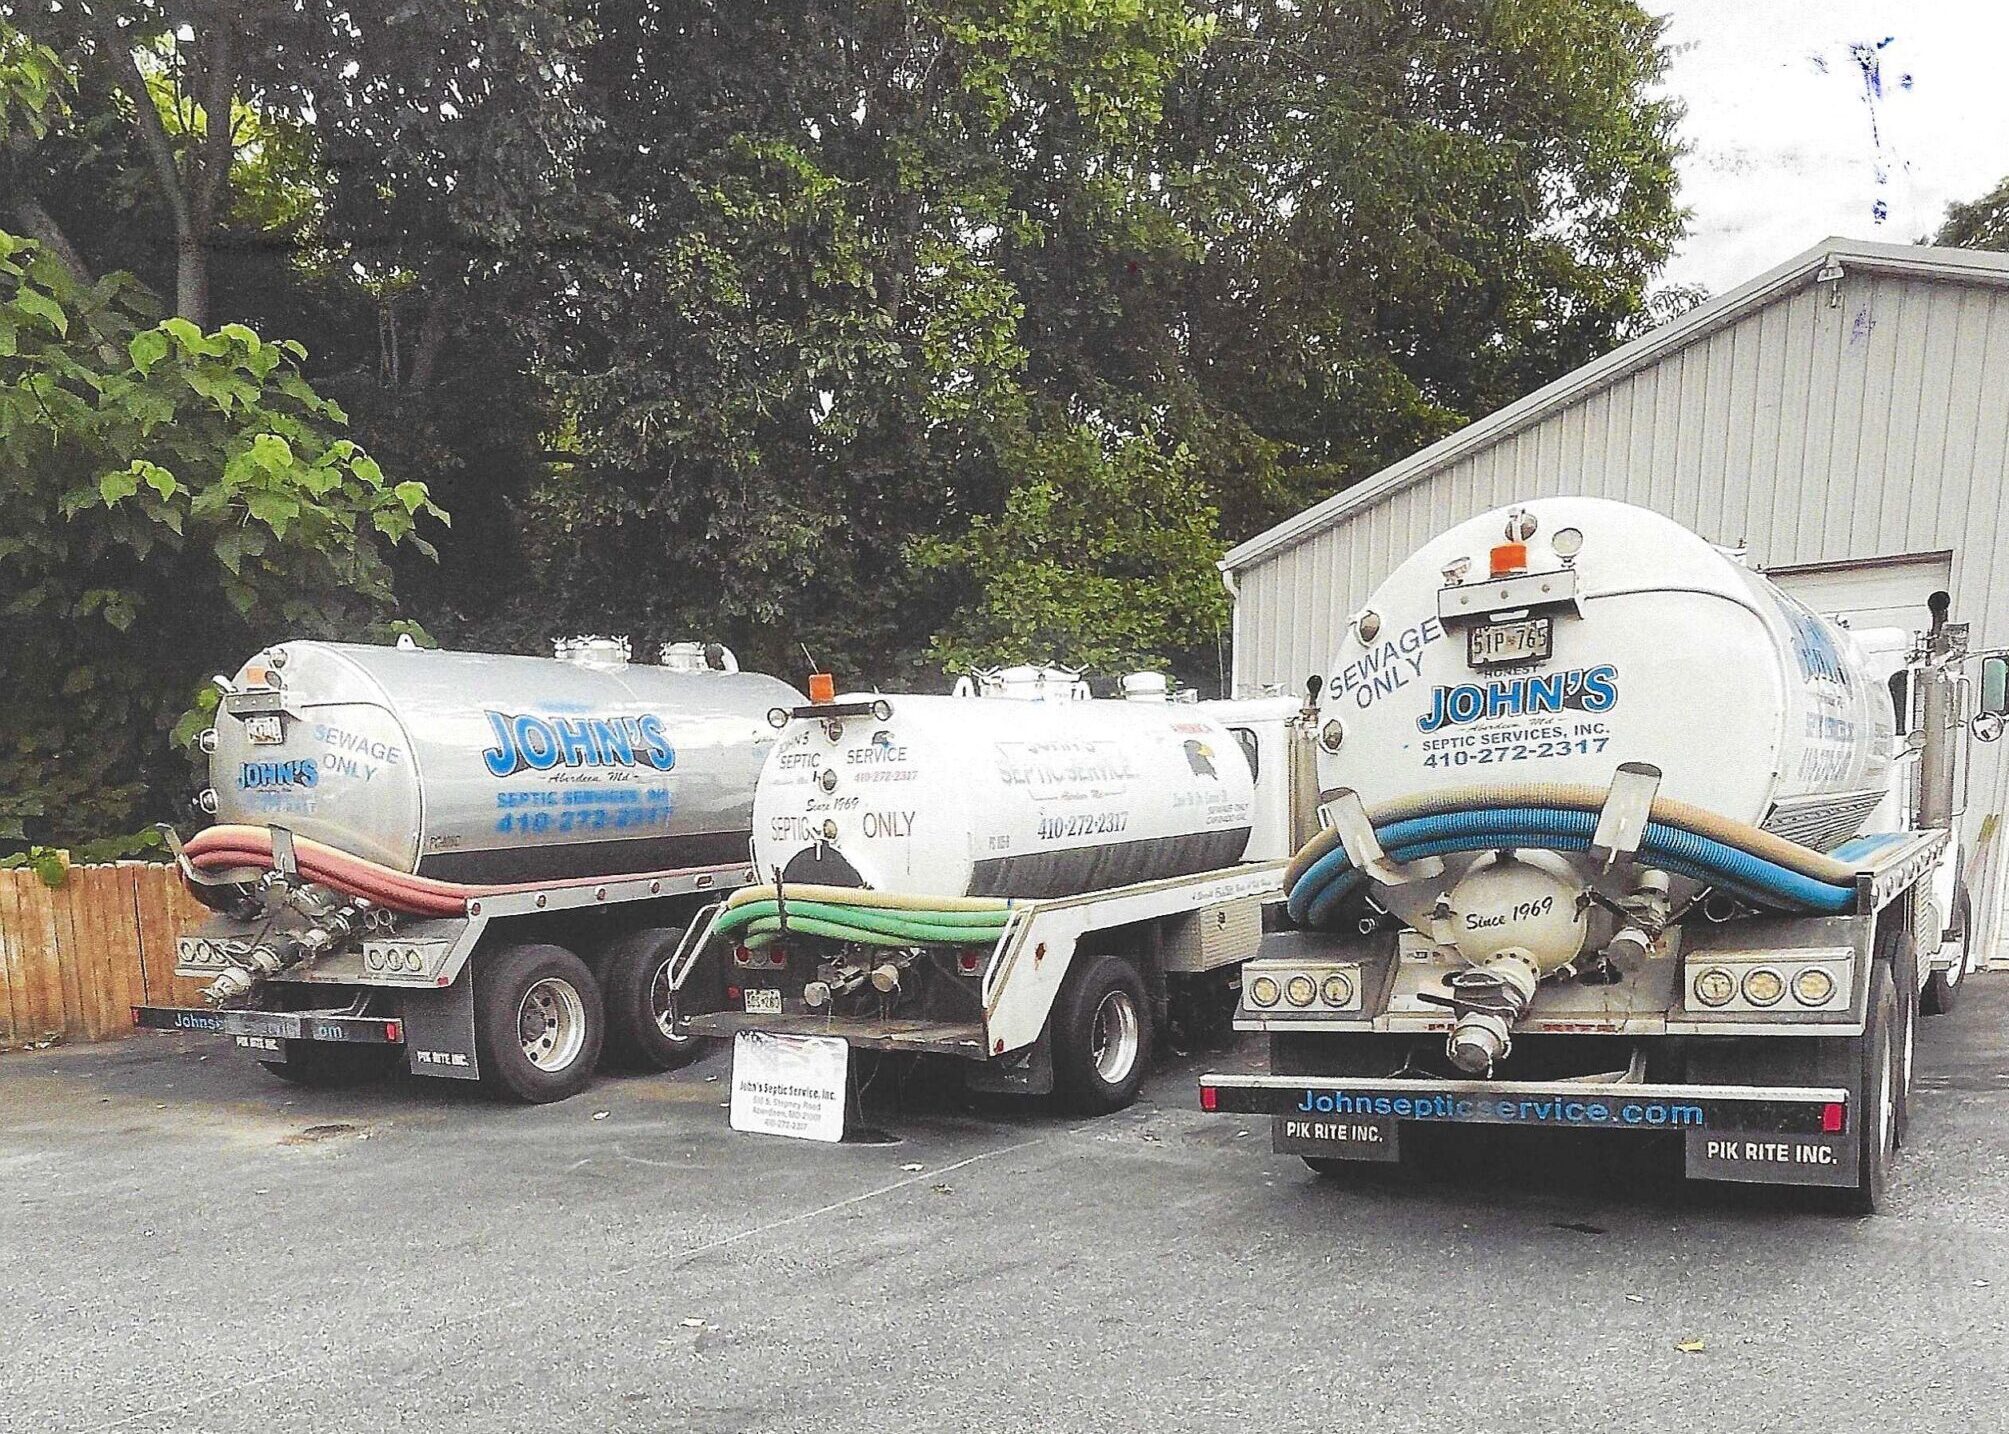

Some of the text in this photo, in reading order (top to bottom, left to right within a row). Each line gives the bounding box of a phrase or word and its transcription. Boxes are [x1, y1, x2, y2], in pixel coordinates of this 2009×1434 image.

[1329, 616, 1441, 700] SEWAGE
[1356, 654, 1424, 710] ONLY
[1416, 664, 1619, 734] JOHN'S
[313, 724, 401, 765] SEWAGE
[483, 709, 677, 777] JOHN'S
[1423, 723, 1610, 752] SEPTIC SERVICES, INC.
[1423, 738, 1610, 769] 410-272-2317
[236, 758, 320, 791] JOHN'S
[322, 753, 378, 783] ONLY
[779, 747, 908, 770] SEPTIC SERVICE
[833, 796, 859, 810] 1969
[863, 811, 916, 839] ONLY
[1465, 896, 1553, 930] Since 1969
[1297, 1088, 1704, 1127] Johnsepticservice.com
[1286, 1121, 1383, 1143] PIK RITE INC.
[1707, 1141, 1838, 1165] PIK RITE INC.
